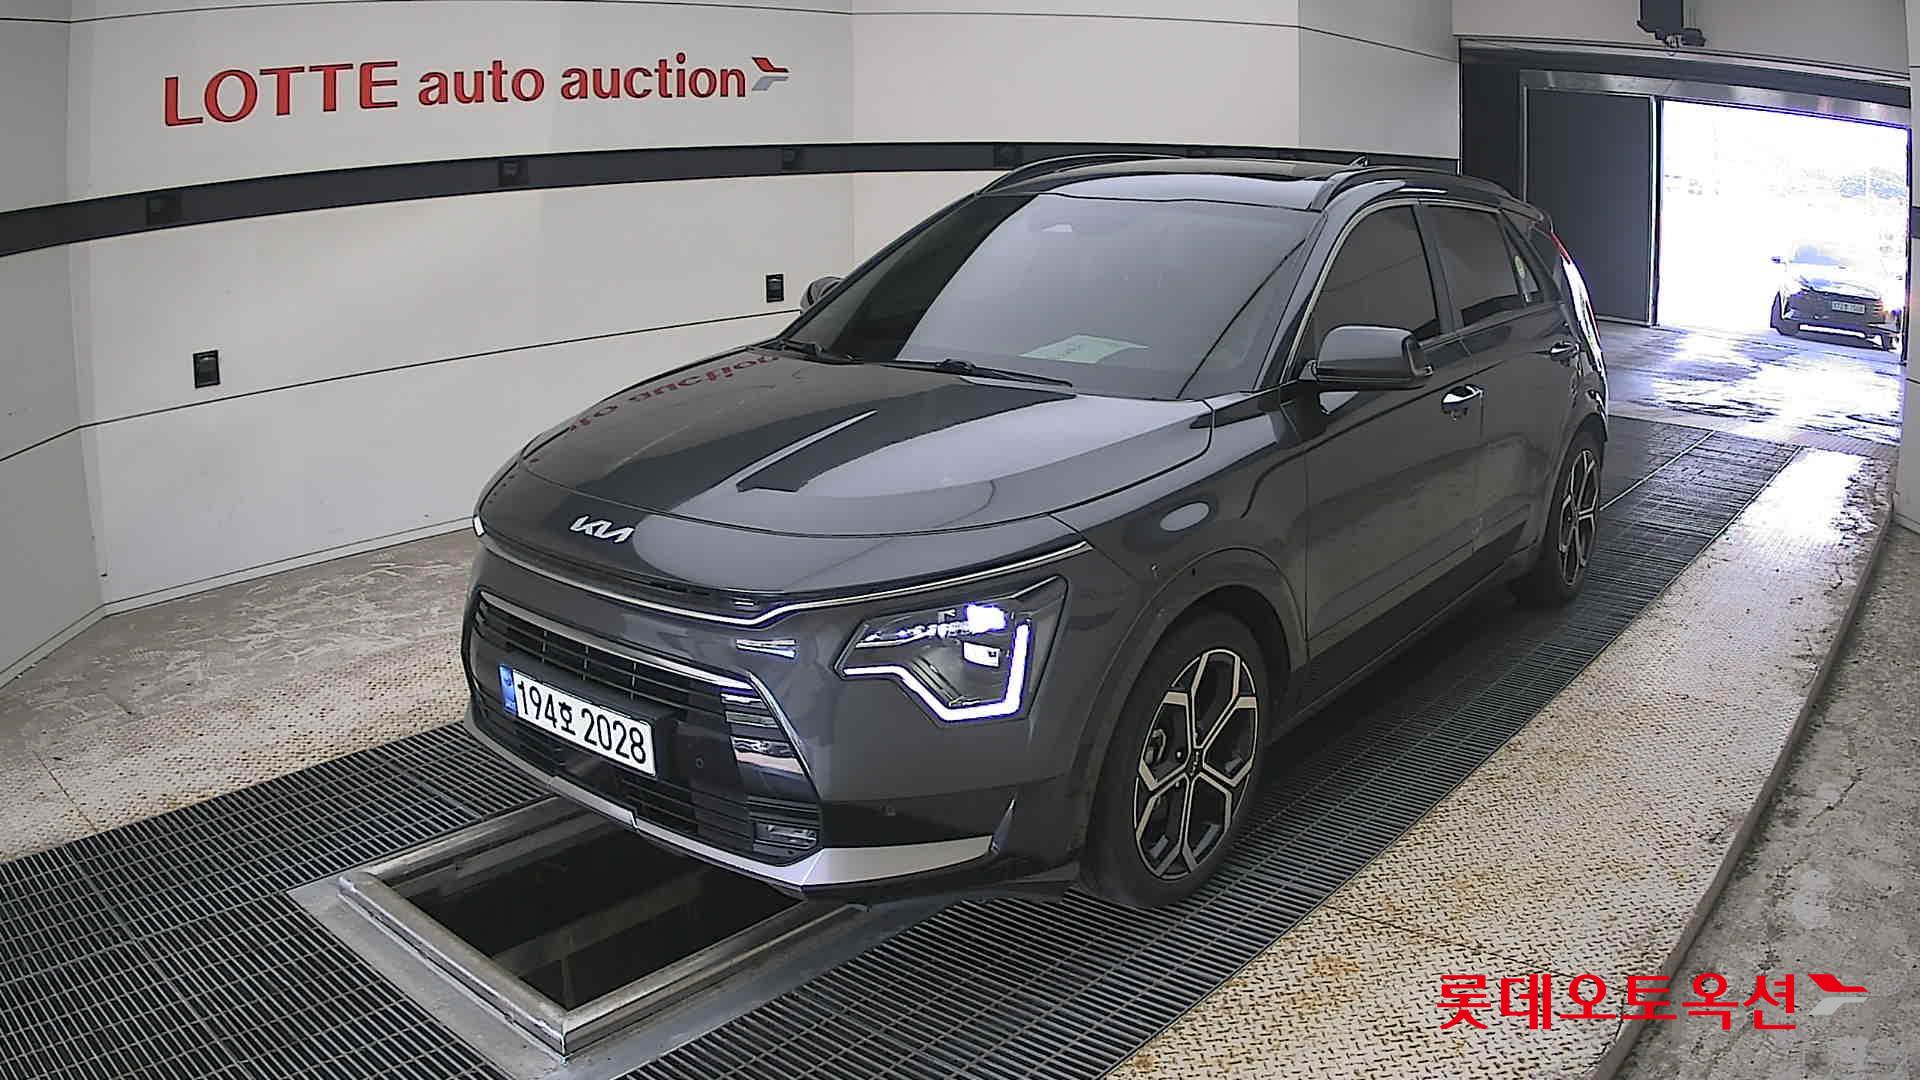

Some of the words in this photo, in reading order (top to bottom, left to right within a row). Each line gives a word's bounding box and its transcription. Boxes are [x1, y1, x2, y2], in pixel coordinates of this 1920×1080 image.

[164, 60, 399, 127] LOTTE
[417, 60, 546, 106] auto
[560, 52, 747, 101] auction
[569, 515, 635, 543] KIA
[580, 707, 647, 765] 2028
